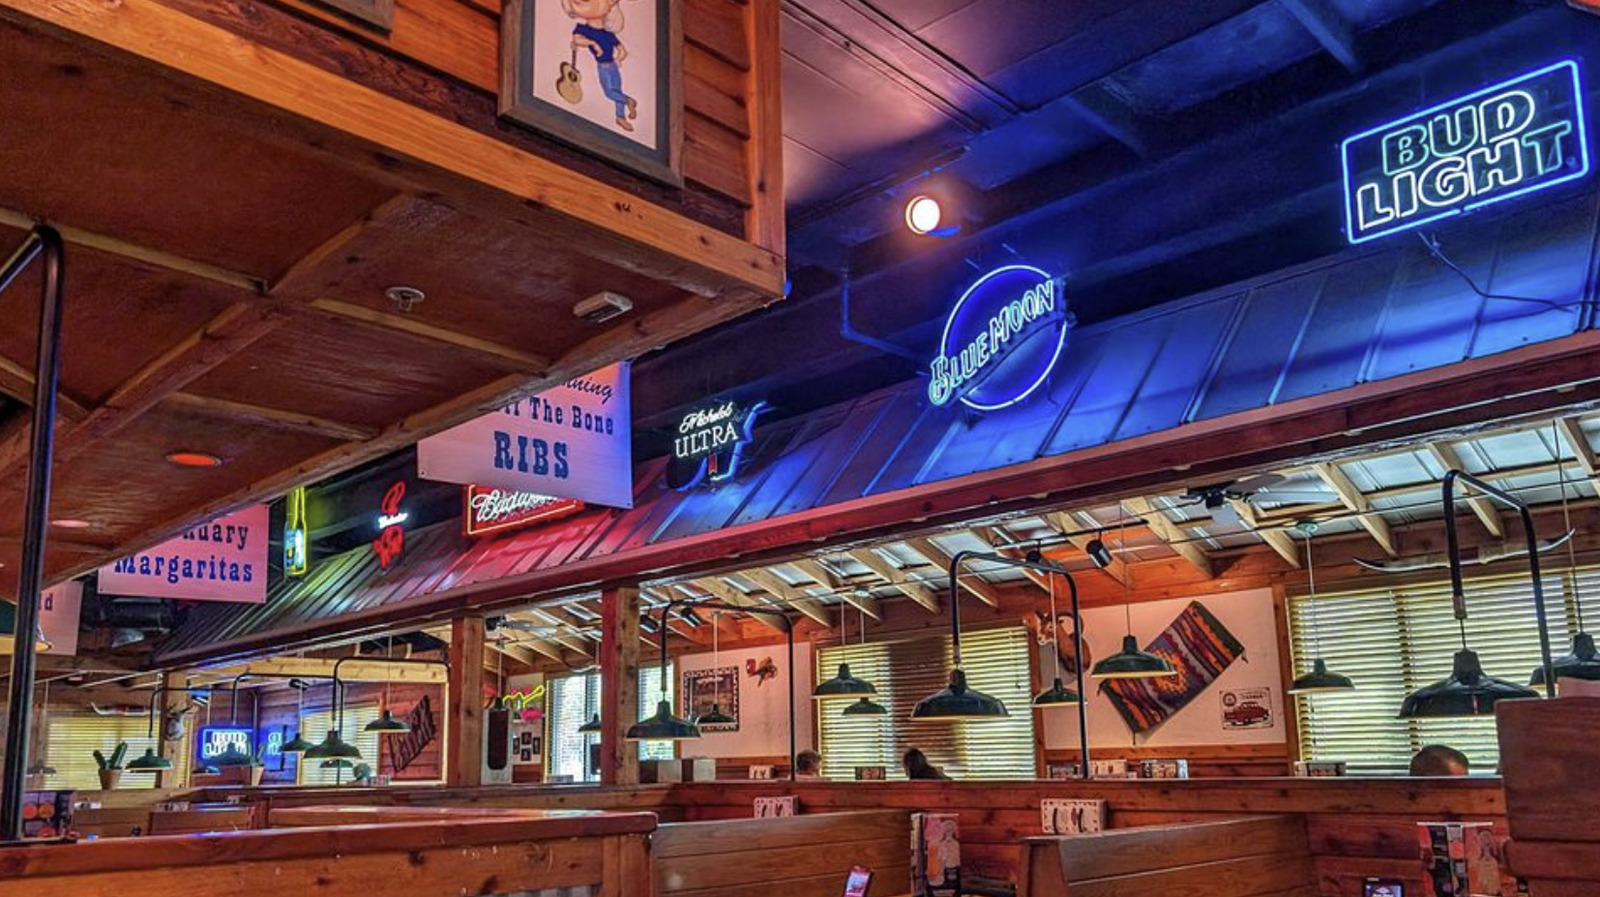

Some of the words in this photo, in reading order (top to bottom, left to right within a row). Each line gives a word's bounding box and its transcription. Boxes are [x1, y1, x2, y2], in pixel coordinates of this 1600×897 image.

[1382, 90, 1535, 175] BUD
[1357, 120, 1571, 230] LIGHT
[929, 332, 989, 405] BLUE
[989, 280, 1054, 354] MOON
[529, 396, 563, 424] The
[572, 405, 614, 435] Bone
[675, 421, 739, 458] ULTRA
[494, 430, 569, 479] RIBS
[114, 554, 253, 584] Margaritas
